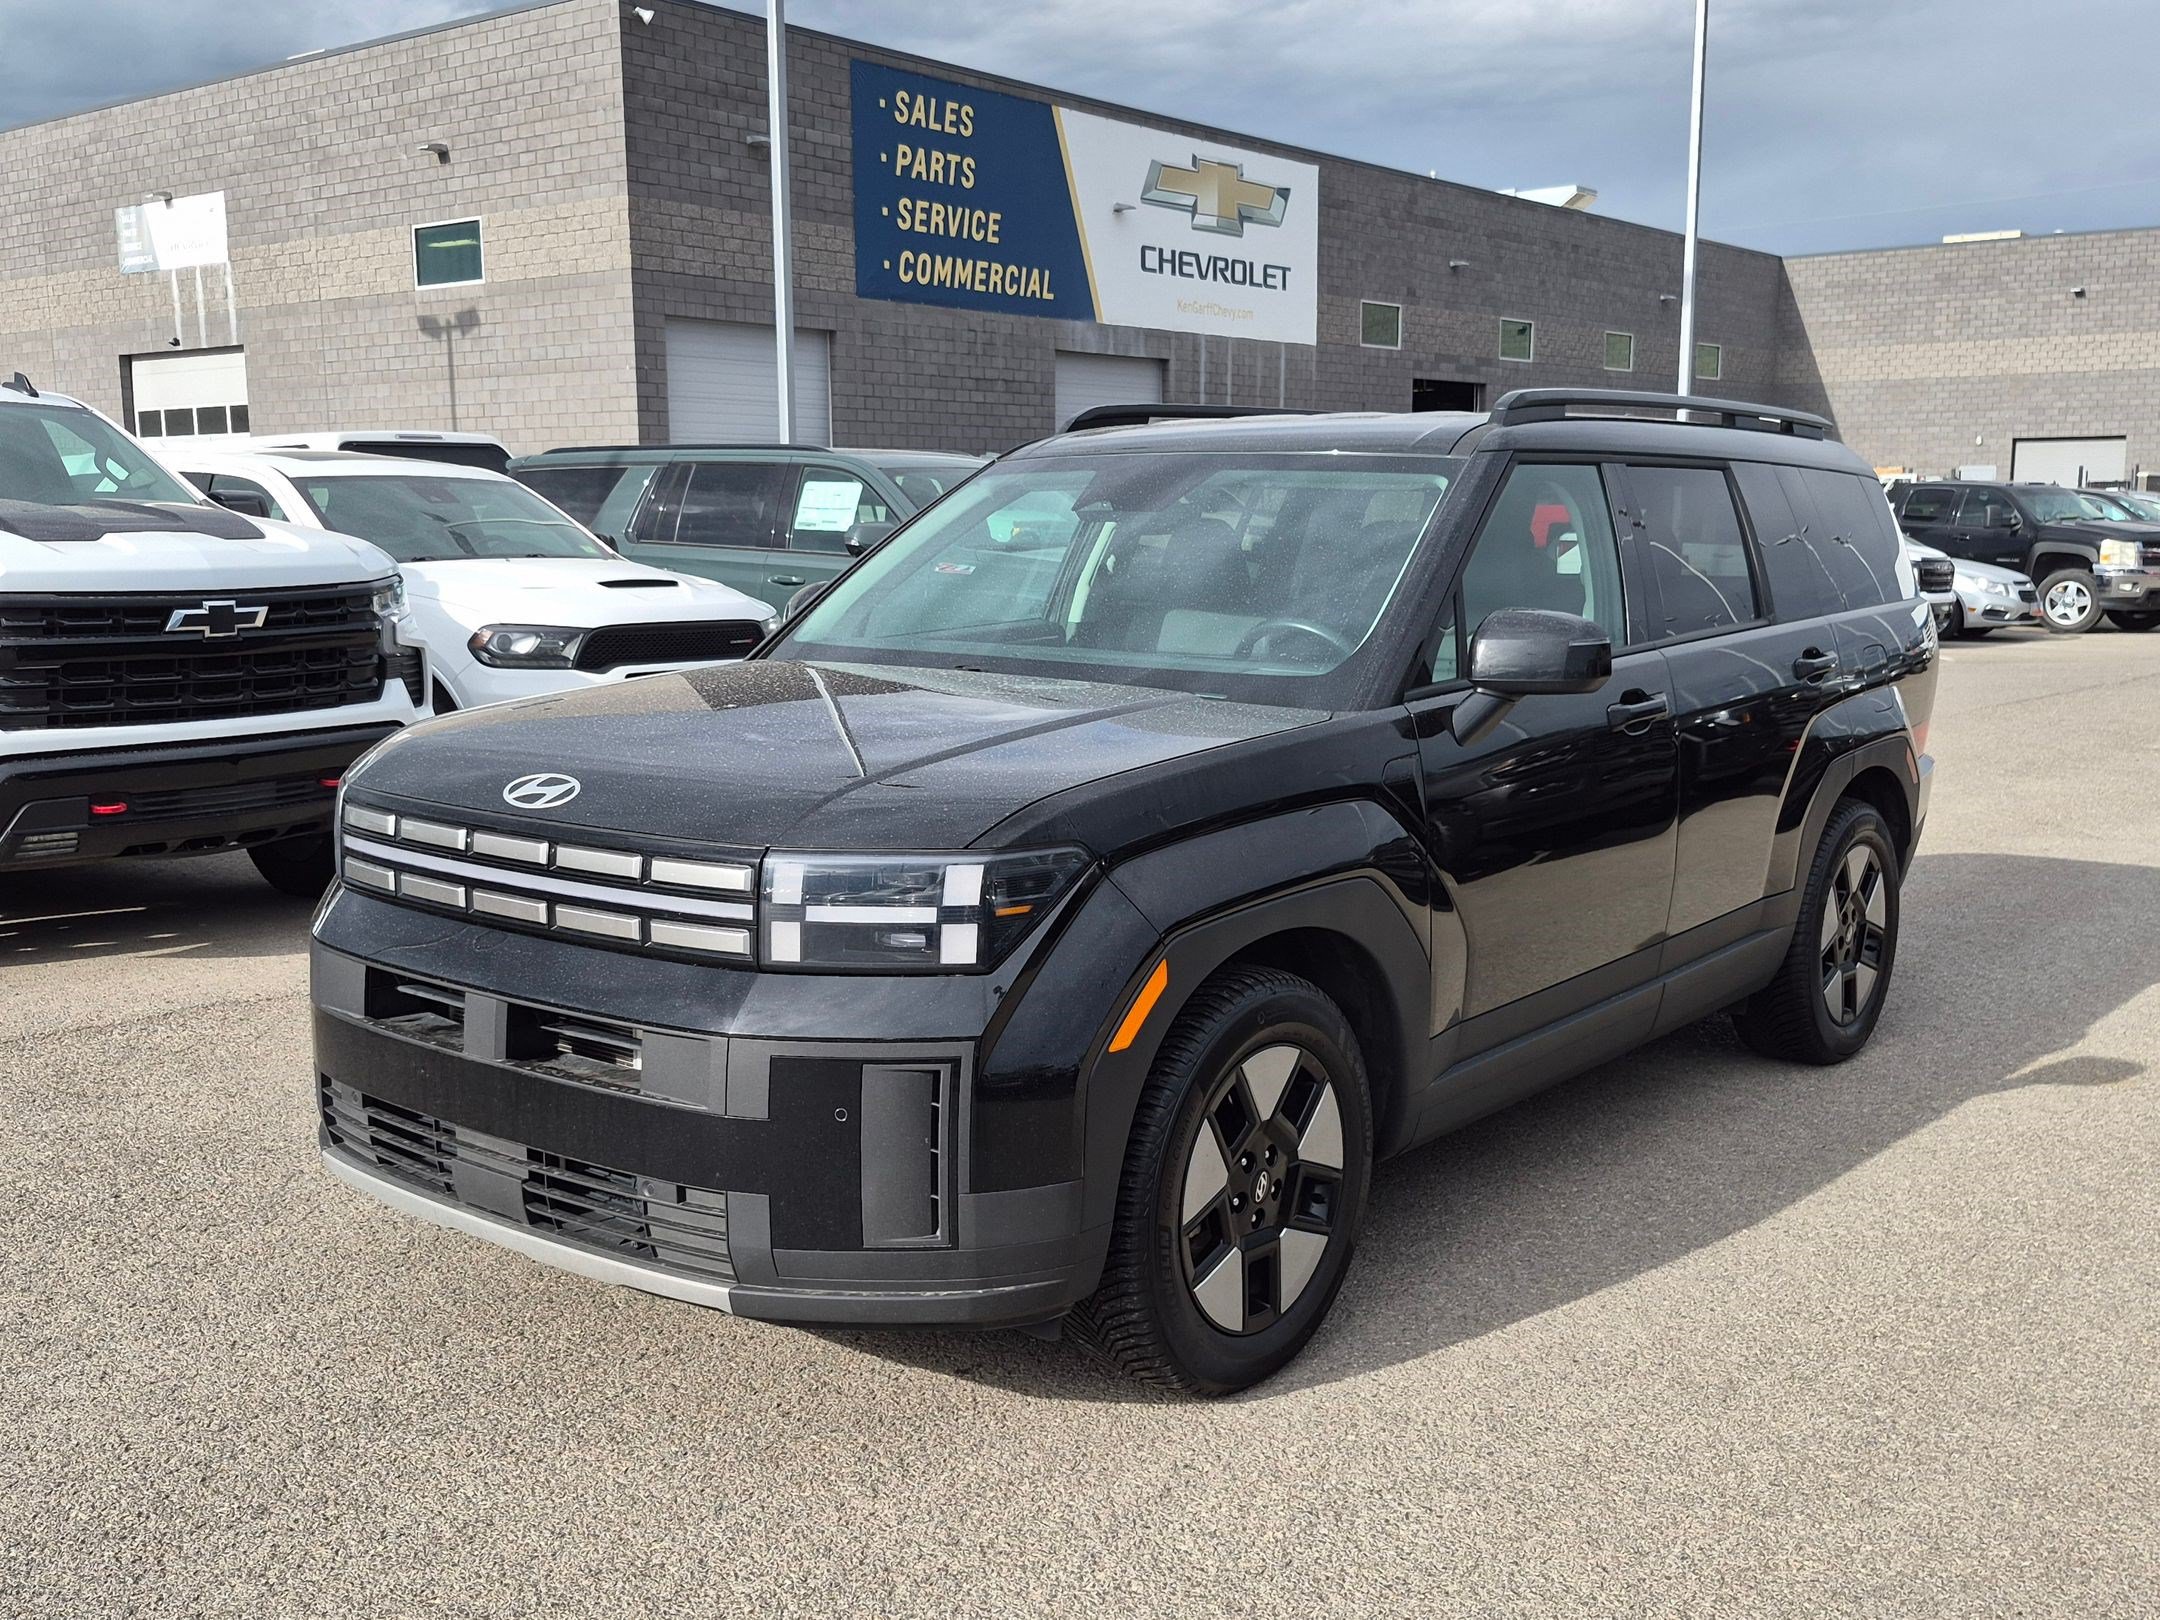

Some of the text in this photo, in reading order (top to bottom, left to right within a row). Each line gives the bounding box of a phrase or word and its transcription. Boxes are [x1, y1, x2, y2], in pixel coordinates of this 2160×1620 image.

[894, 90, 975, 137] SALES
[895, 143, 977, 189] PARTS
[896, 197, 1002, 244] SERVICE
[898, 250, 1055, 300] COMMERCIAL
[1140, 244, 1292, 291] CHEVROLET
